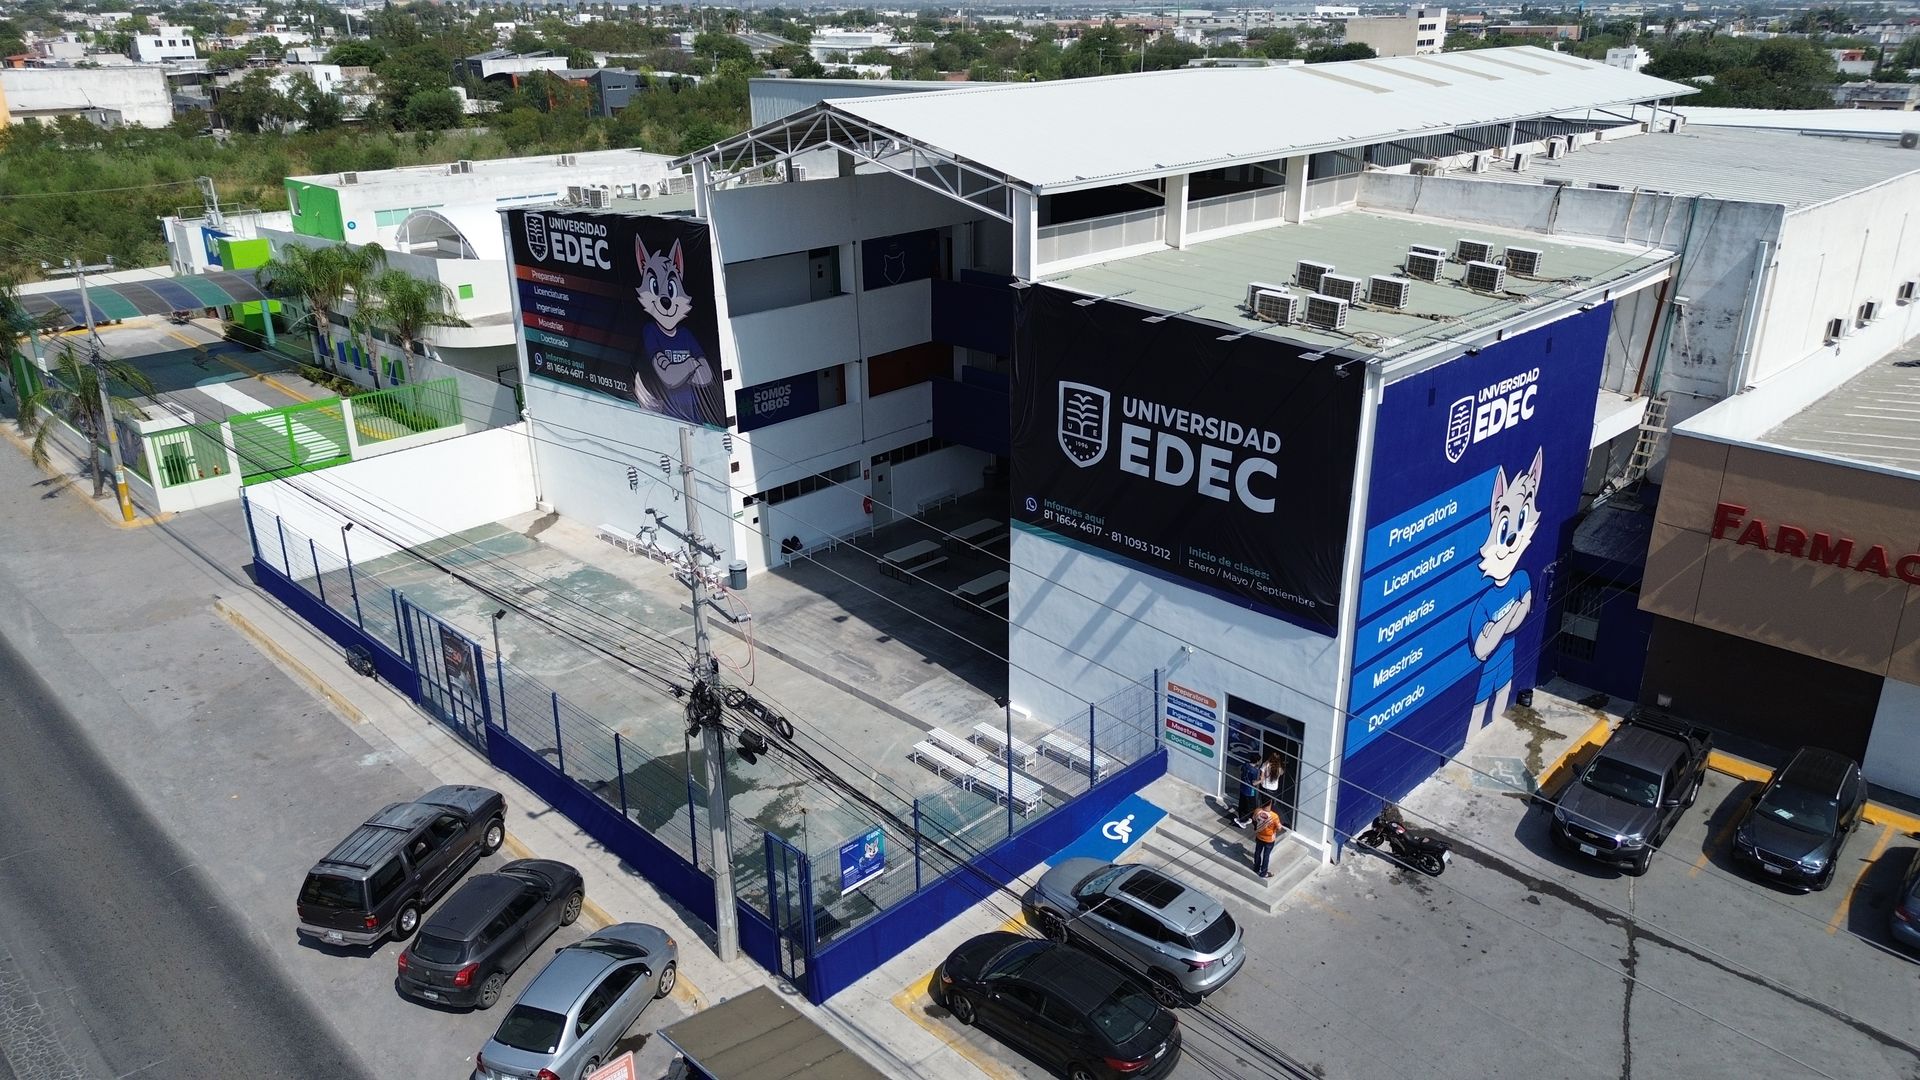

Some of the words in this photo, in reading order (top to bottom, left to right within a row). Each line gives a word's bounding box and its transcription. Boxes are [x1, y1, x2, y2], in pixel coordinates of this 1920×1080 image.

[548, 216, 607, 238] UNIVERSIDAD
[551, 232, 612, 270] EDEC
[531, 270, 565, 284] Preparatoria
[534, 285, 569, 301] Licenciaturas
[540, 334, 569, 348] Doctorado
[545, 352, 571, 366] Informes
[546, 362, 553, 371] 81
[554, 364, 569, 375] 1664
[570, 369, 584, 379] 4617
[589, 374, 596, 383] 81
[597, 376, 613, 388] 1093
[614, 380, 628, 391] 1212
[754, 384, 792, 403] SOMOS
[1478, 367, 1539, 402] UNIVERSIDAD
[754, 396, 790, 414] LOBOS
[1473, 384, 1538, 444] EDEC
[1122, 396, 1281, 454] UNIVERSIDAD
[1120, 422, 1278, 514] EDEC
[1044, 498, 1082, 518] Informes
[1389, 499, 1457, 546] Preparatoria
[1044, 510, 1053, 520] 81
[1056, 512, 1077, 528] 1664
[1080, 521, 1102, 536] 4617
[1112, 531, 1121, 543] 81
[1124, 536, 1148, 552] 1093
[1150, 544, 1171, 560] 1212
[1189, 546, 1217, 562] Inicio
[1219, 557, 1232, 567] de
[1234, 562, 1270, 580] clases:
[1383, 546, 1455, 596] Licenciaturas
[1188, 559, 1216, 575] Enero
[1216, 568, 1221, 577] /
[1223, 570, 1248, 586] Mayo
[1250, 579, 1255, 588] /
[1256, 582, 1316, 608] Septiembre
[1378, 600, 1435, 643] Ingenierías
[1373, 647, 1423, 688] Maestrías
[1173, 686, 1209, 705] Preparatoria
[1368, 685, 1424, 732] Doctorado
[1170, 735, 1202, 752] Doctorado
